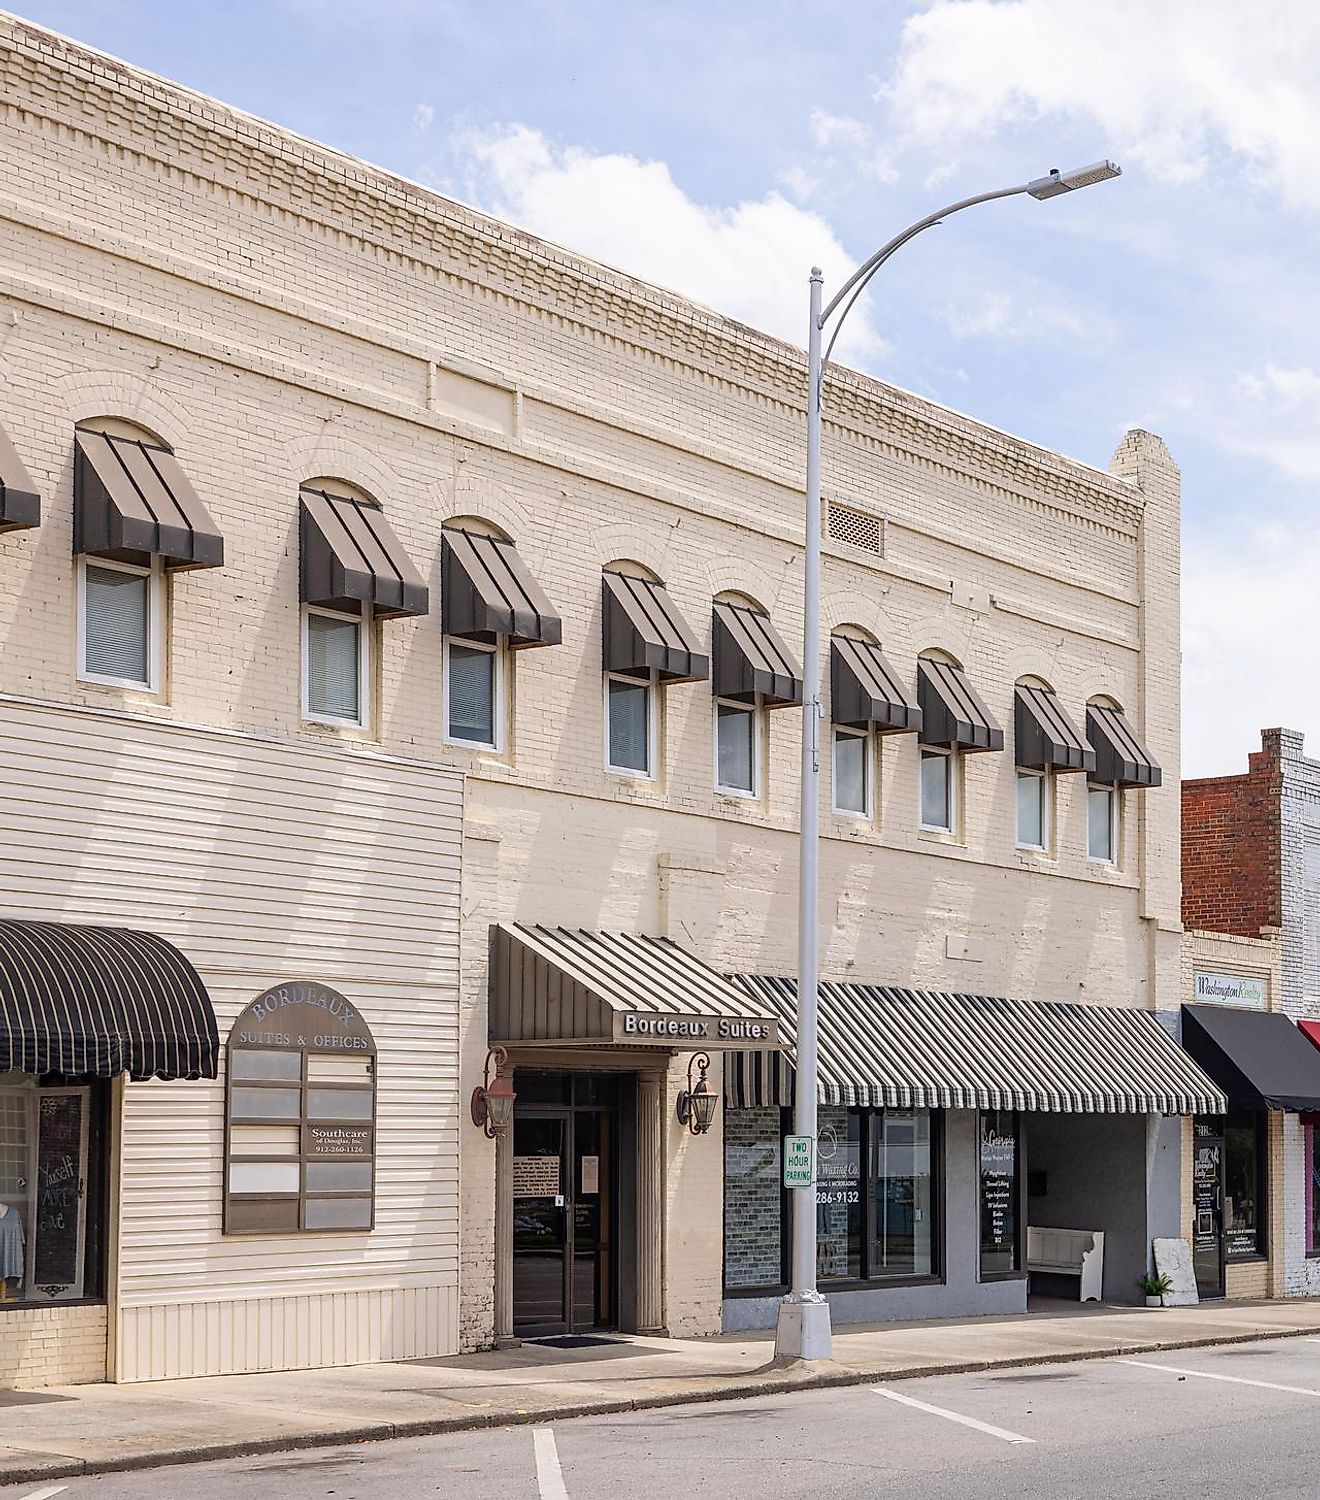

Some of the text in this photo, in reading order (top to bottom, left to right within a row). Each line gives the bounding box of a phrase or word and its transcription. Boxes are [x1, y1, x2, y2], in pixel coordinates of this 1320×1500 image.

[1198, 976, 1238, 1001] Washington
[252, 986, 356, 1028] BORDEAUX
[625, 1014, 770, 1038] Bordeaux Suites
[240, 1031, 368, 1049] SUITES & OFFICES
[311, 1128, 368, 1138] Southcare
[792, 1142, 807, 1152] TWO
[788, 1156, 809, 1166] HOUR
[786, 1170, 811, 1181] PARKING
